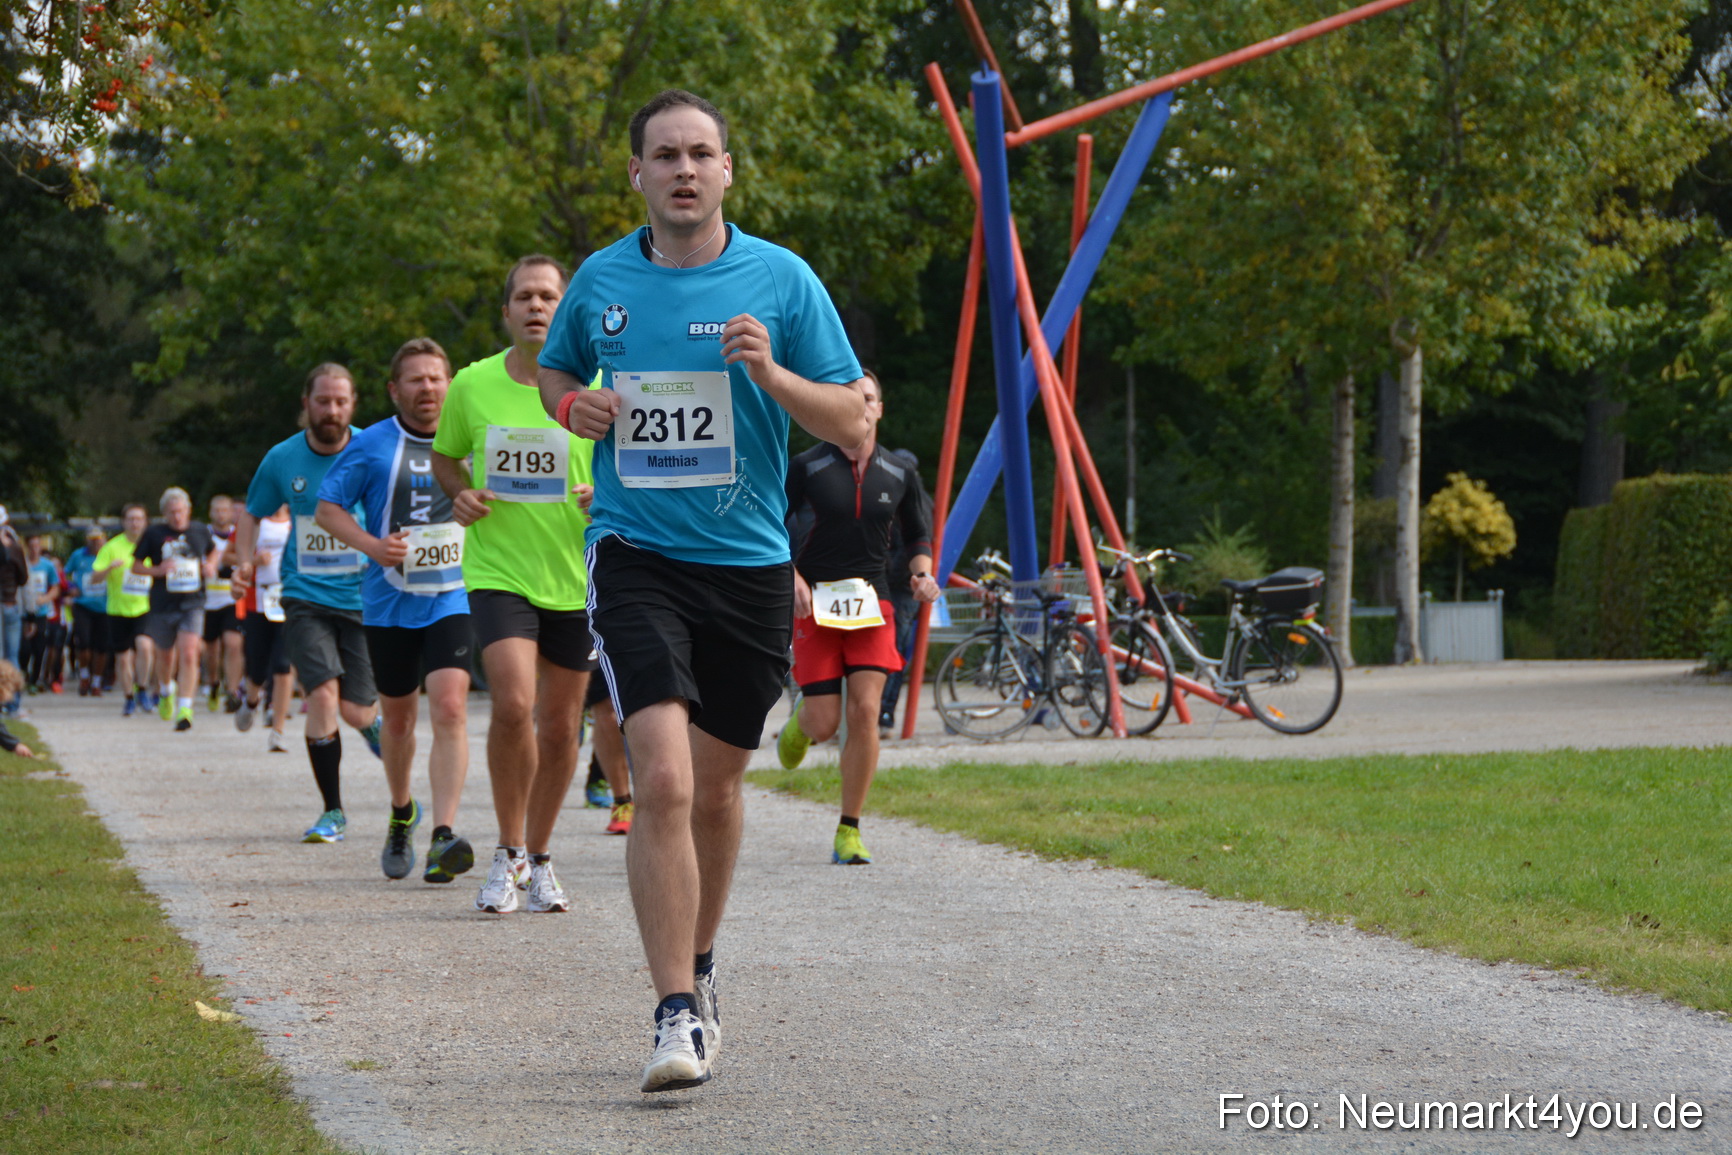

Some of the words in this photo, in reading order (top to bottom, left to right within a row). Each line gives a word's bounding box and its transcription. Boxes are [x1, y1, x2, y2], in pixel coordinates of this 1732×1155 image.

[604, 305, 627, 316] BMW
[600, 341, 626, 350] PARTL
[652, 381, 695, 393] BOCK
[630, 406, 714, 443] 2312
[496, 449, 555, 474] 2193
[647, 455, 699, 468] Matthias
[511, 480, 539, 490] Martin
[415, 542, 459, 567] 2903
[829, 598, 864, 617] 417
